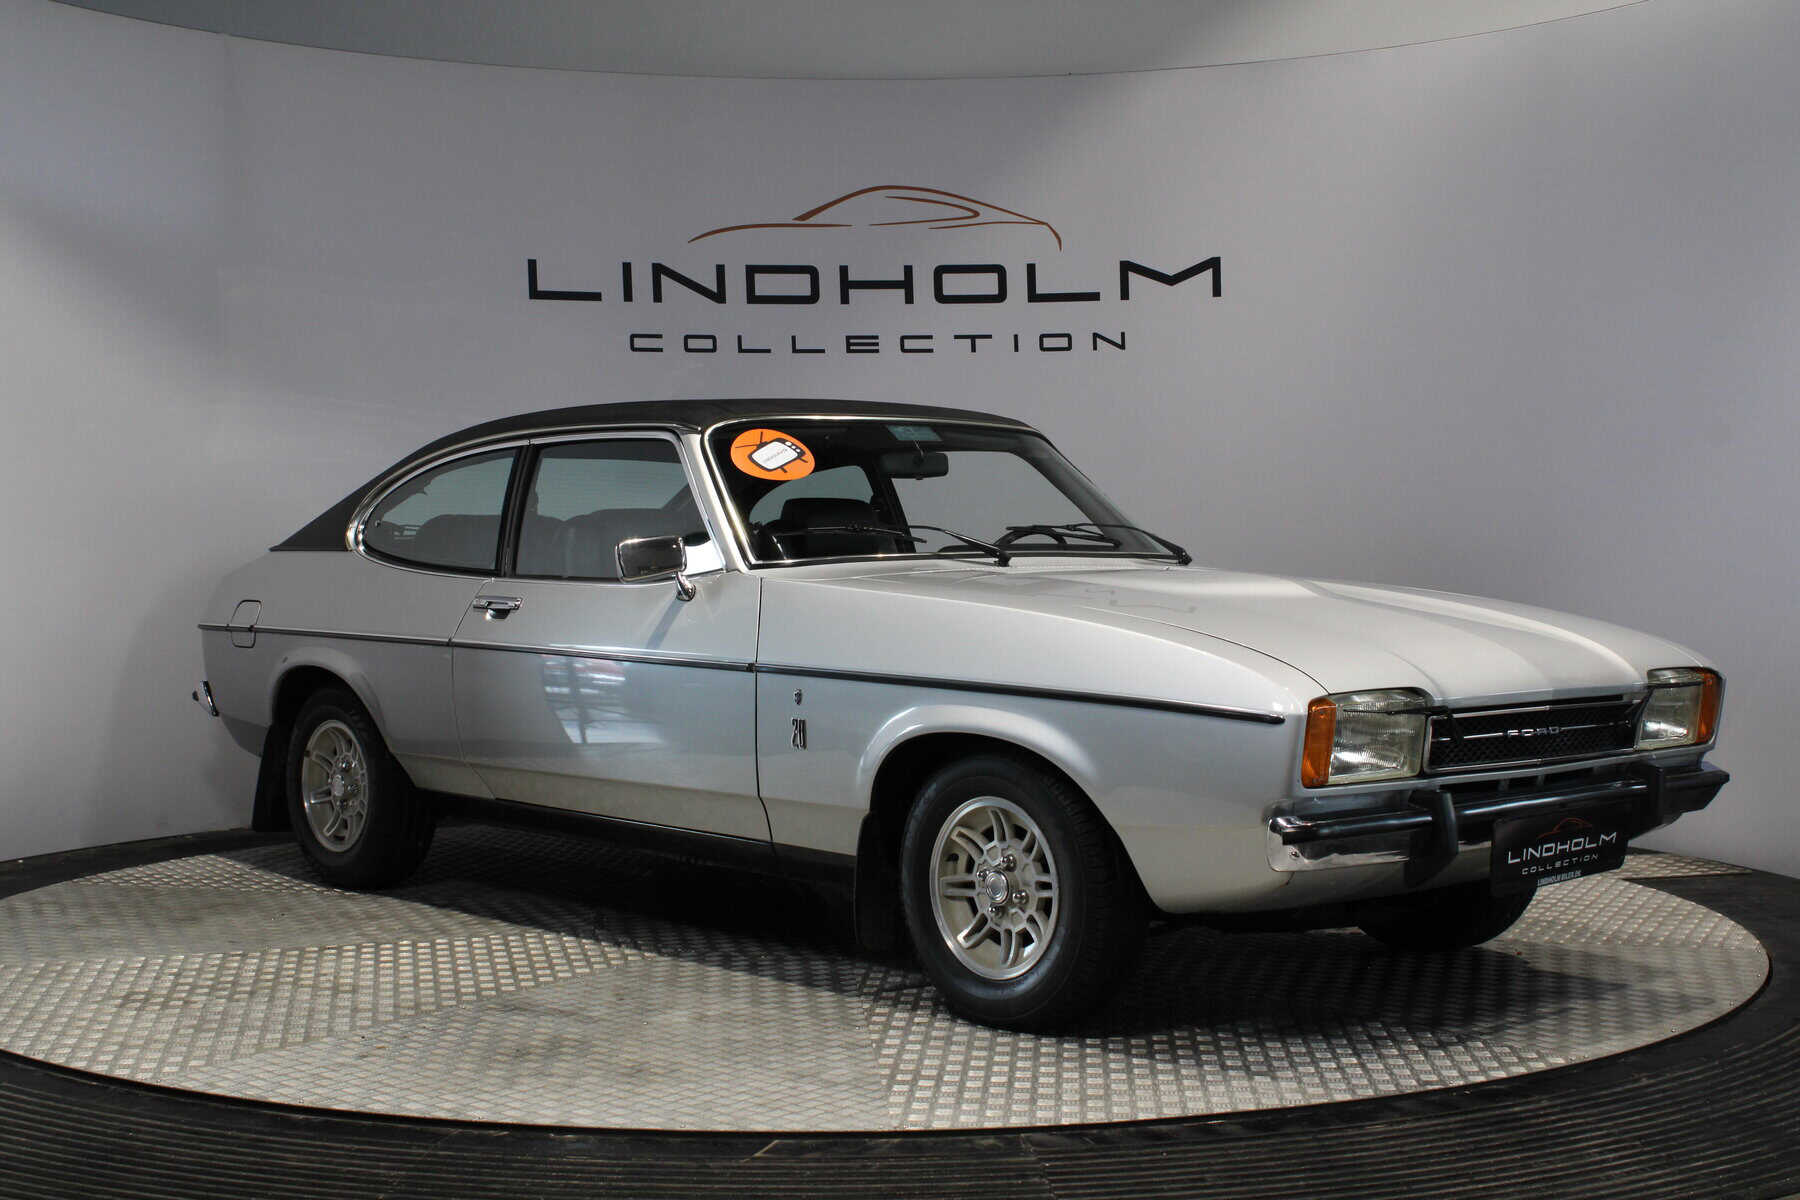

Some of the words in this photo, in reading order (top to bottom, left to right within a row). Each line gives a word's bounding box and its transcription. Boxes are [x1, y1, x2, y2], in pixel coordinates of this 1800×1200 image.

[528, 257, 1222, 305] LINDHOLM
[629, 331, 1126, 354] COLLECTION
[1507, 726, 1560, 738] FORD
[1507, 832, 1617, 865] LINDHOLM
[1521, 854, 1599, 875] COLLECTION
